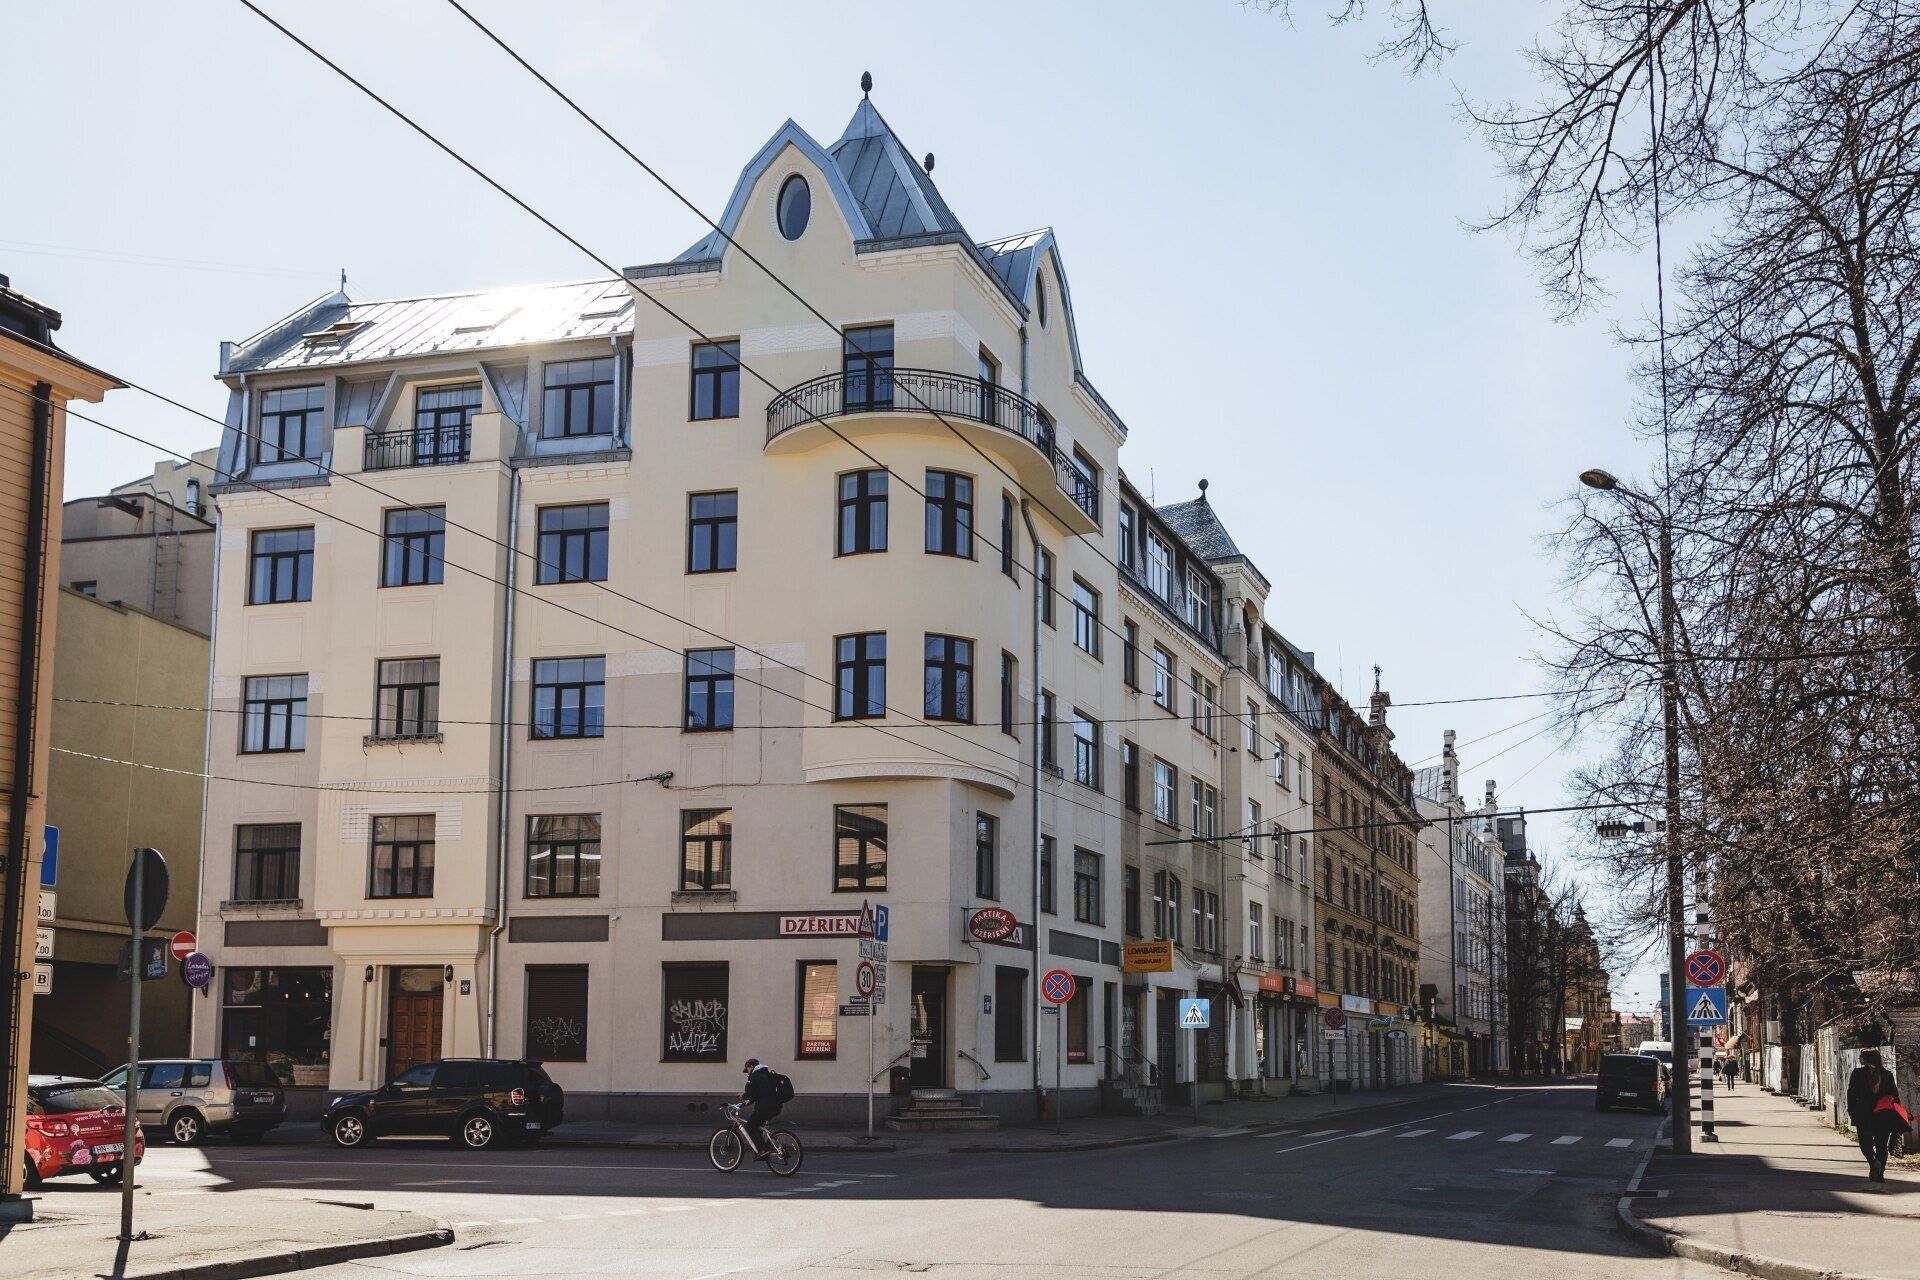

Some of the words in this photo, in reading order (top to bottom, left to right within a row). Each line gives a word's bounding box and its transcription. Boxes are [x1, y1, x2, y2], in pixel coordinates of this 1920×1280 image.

[785, 916, 860, 933] DZĒRIEN
[1127, 946, 1168, 955] LOMBARDS
[37, 974, 47, 984] B
[861, 970, 871, 988] 30
